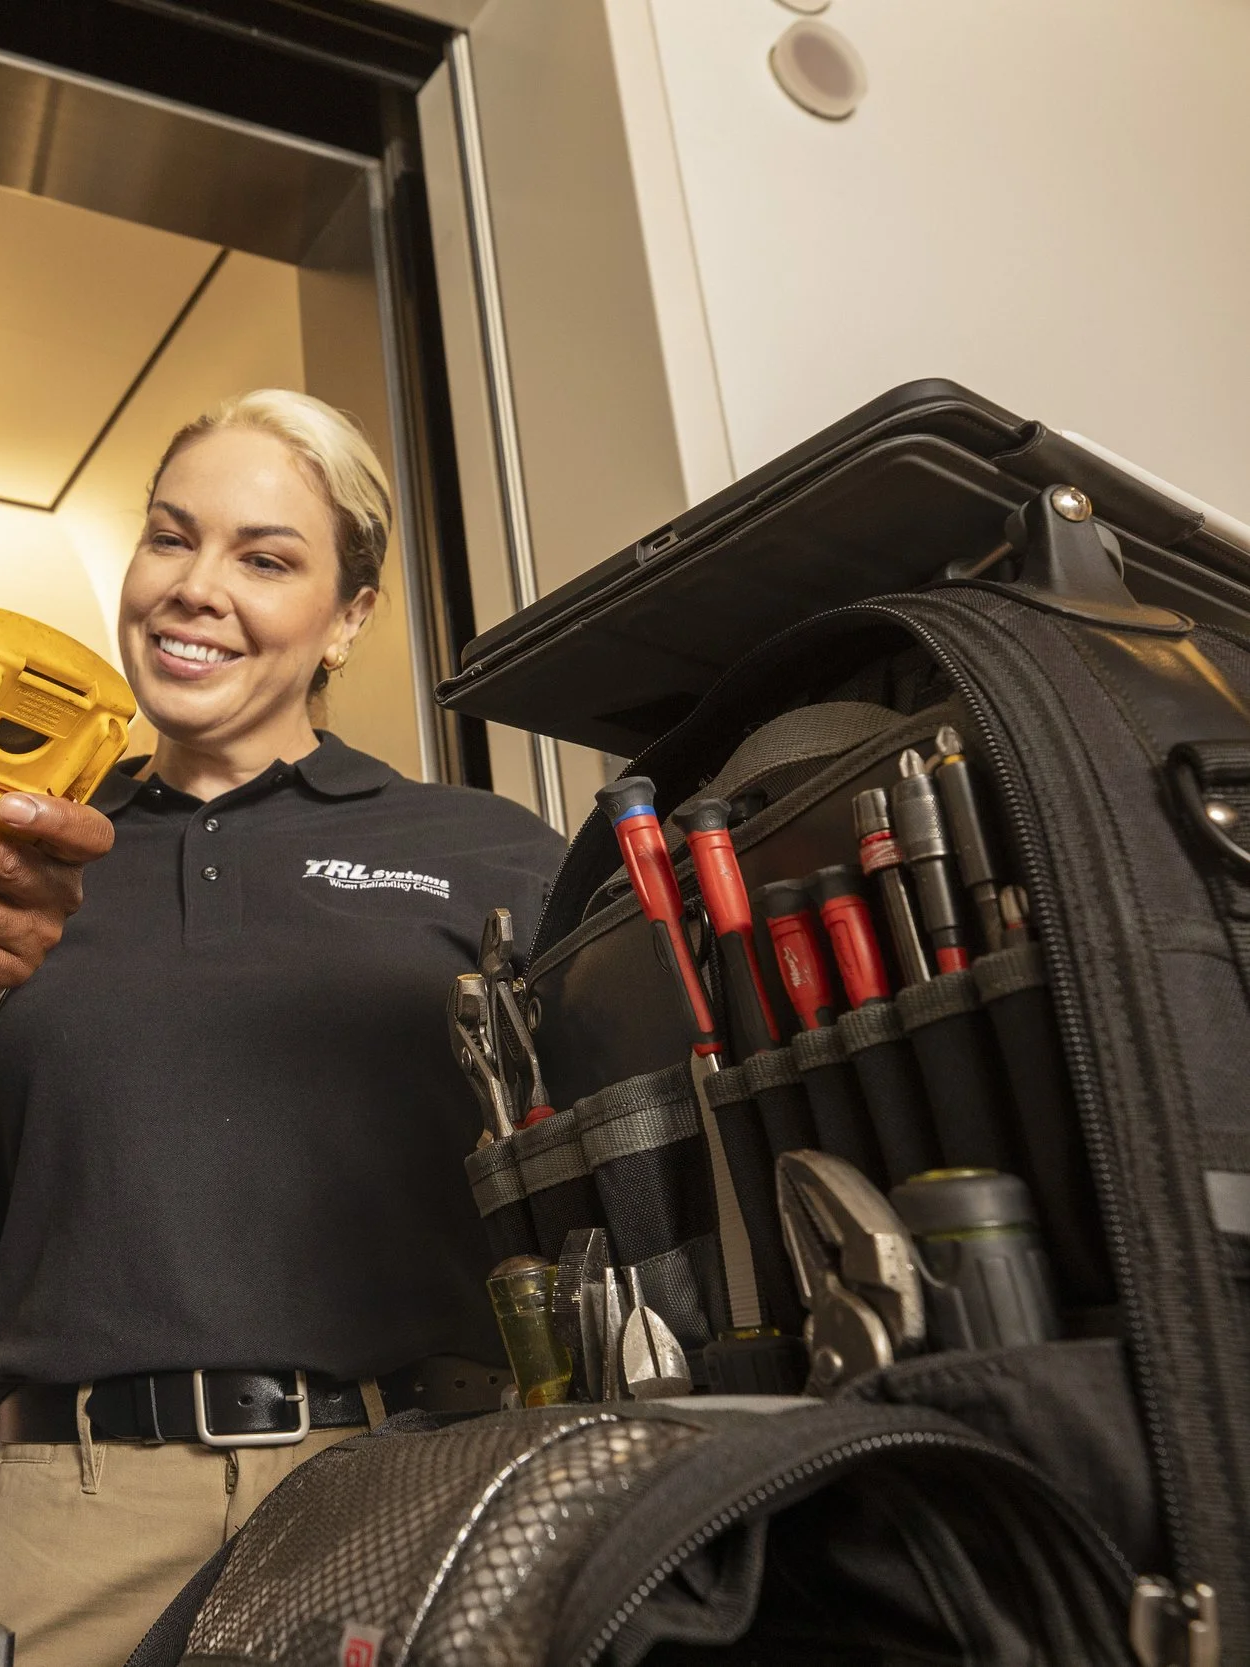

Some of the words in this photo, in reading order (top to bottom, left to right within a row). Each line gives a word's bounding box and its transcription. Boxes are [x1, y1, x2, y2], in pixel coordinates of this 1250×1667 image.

[305, 859, 370, 880] TRL
[329, 879, 358, 890] When
[360, 880, 412, 892] Reliability
[413, 882, 450, 899] Counts
